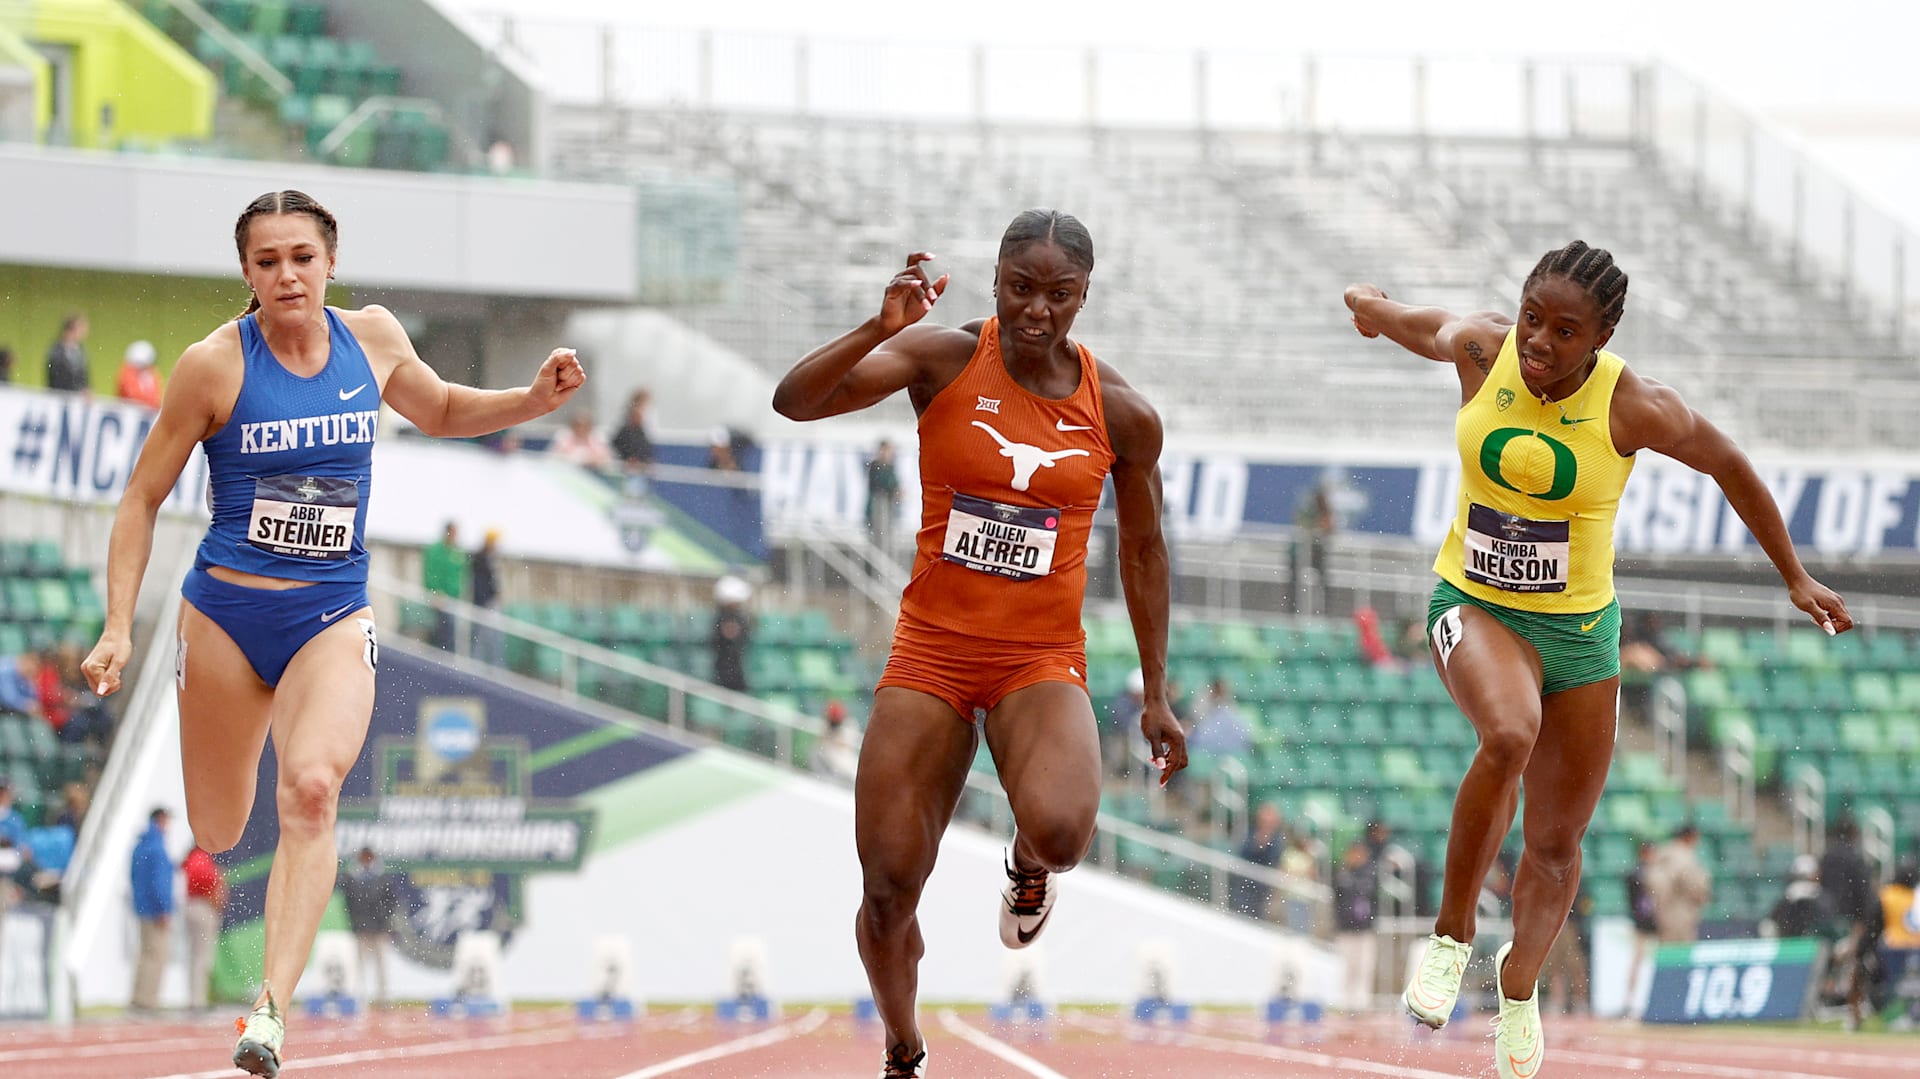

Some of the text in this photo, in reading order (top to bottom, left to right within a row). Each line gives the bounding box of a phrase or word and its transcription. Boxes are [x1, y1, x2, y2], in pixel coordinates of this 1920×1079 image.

[1480, 427, 1577, 501] O
[289, 505, 325, 523] ABBY
[1813, 472, 1907, 558] OF
[257, 516, 347, 548] STEINER
[977, 521, 1027, 543] JULIEN
[954, 531, 1040, 569] ALFRED
[1491, 539, 1538, 558] KEMBA
[1472, 549, 1558, 581] NELSON
[1440, 616, 1456, 655] 4
